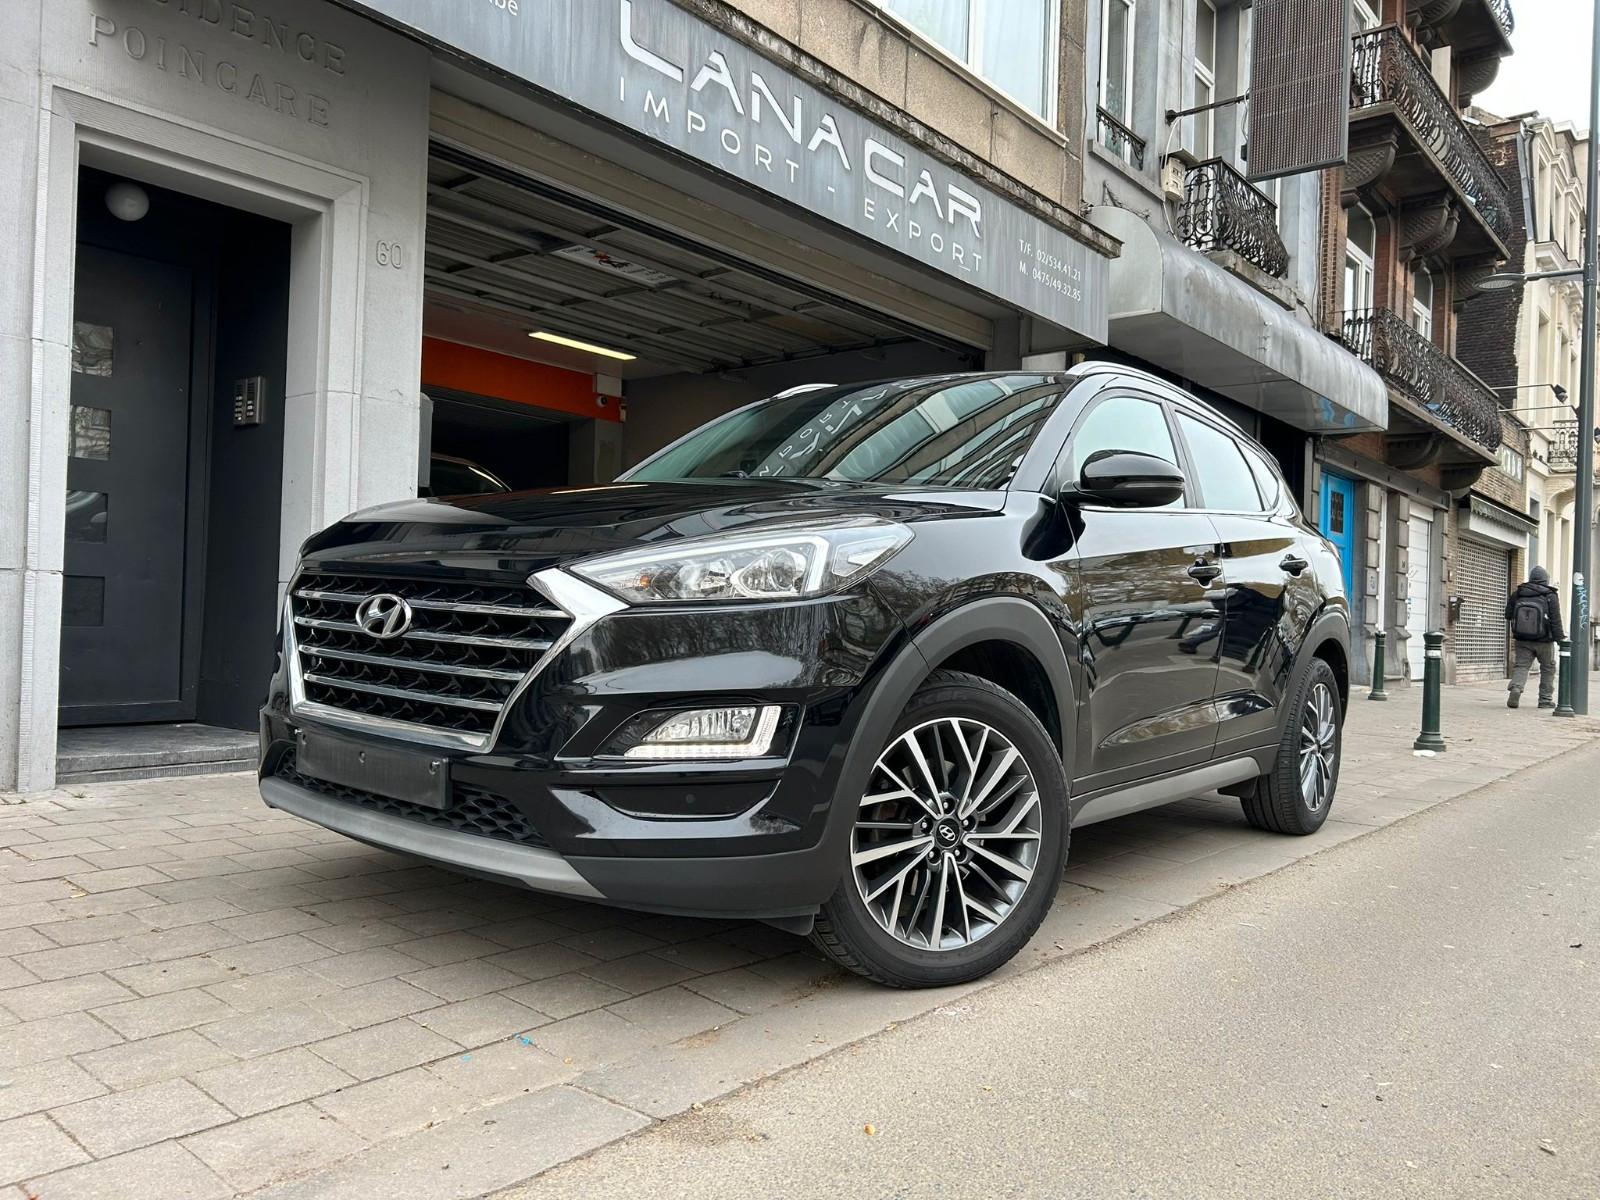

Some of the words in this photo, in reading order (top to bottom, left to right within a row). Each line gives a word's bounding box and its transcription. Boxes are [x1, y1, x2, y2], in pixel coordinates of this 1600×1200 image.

[620, 76, 799, 183] IMPORT
[864, 197, 982, 273] EXPORT
[376, 240, 401, 269] 60
[1037, 249, 1081, 281] 02/534.41.21
